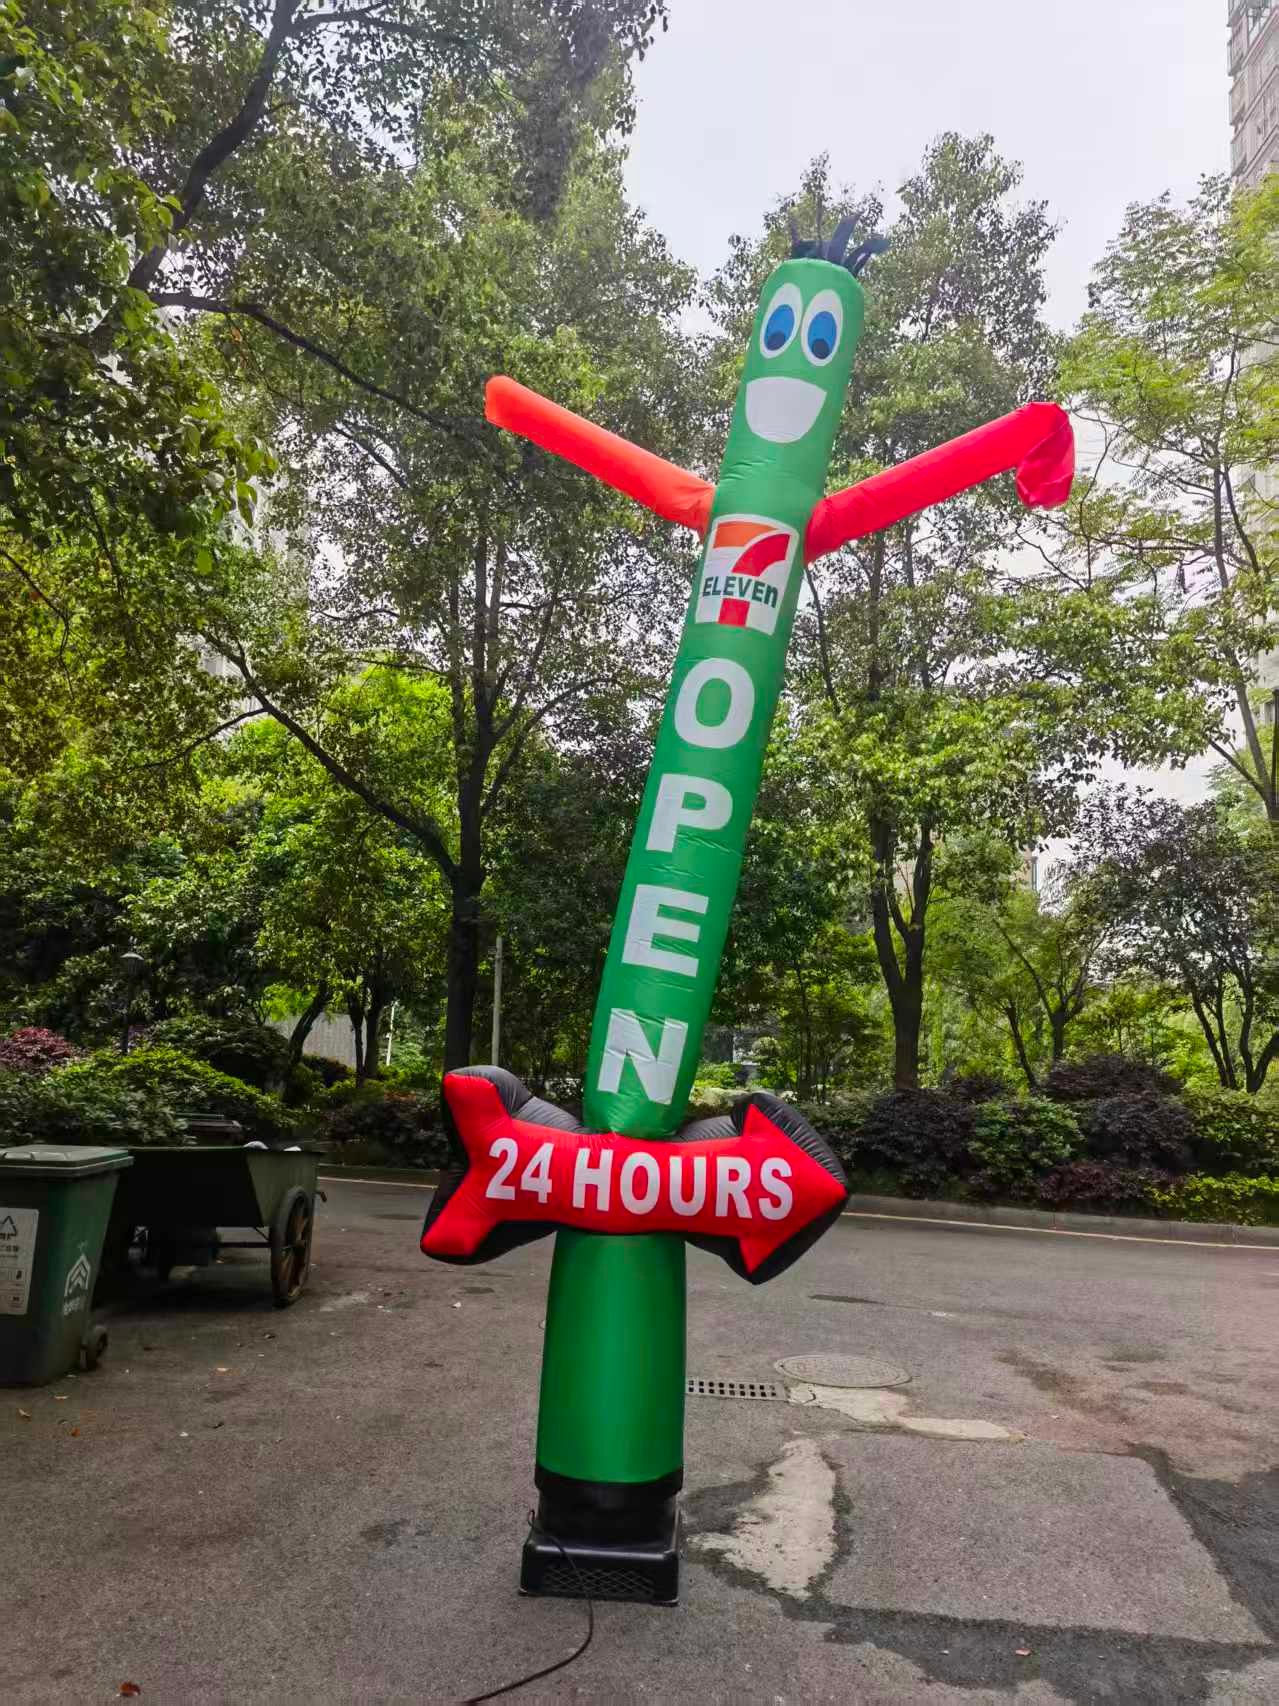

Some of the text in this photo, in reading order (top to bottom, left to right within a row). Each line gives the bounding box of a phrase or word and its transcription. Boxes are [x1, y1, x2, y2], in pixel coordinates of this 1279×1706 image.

[713, 520, 790, 628] 7
[597, 657, 756, 1105] OPEN
[485, 1137, 794, 1221] 24 HOURS
